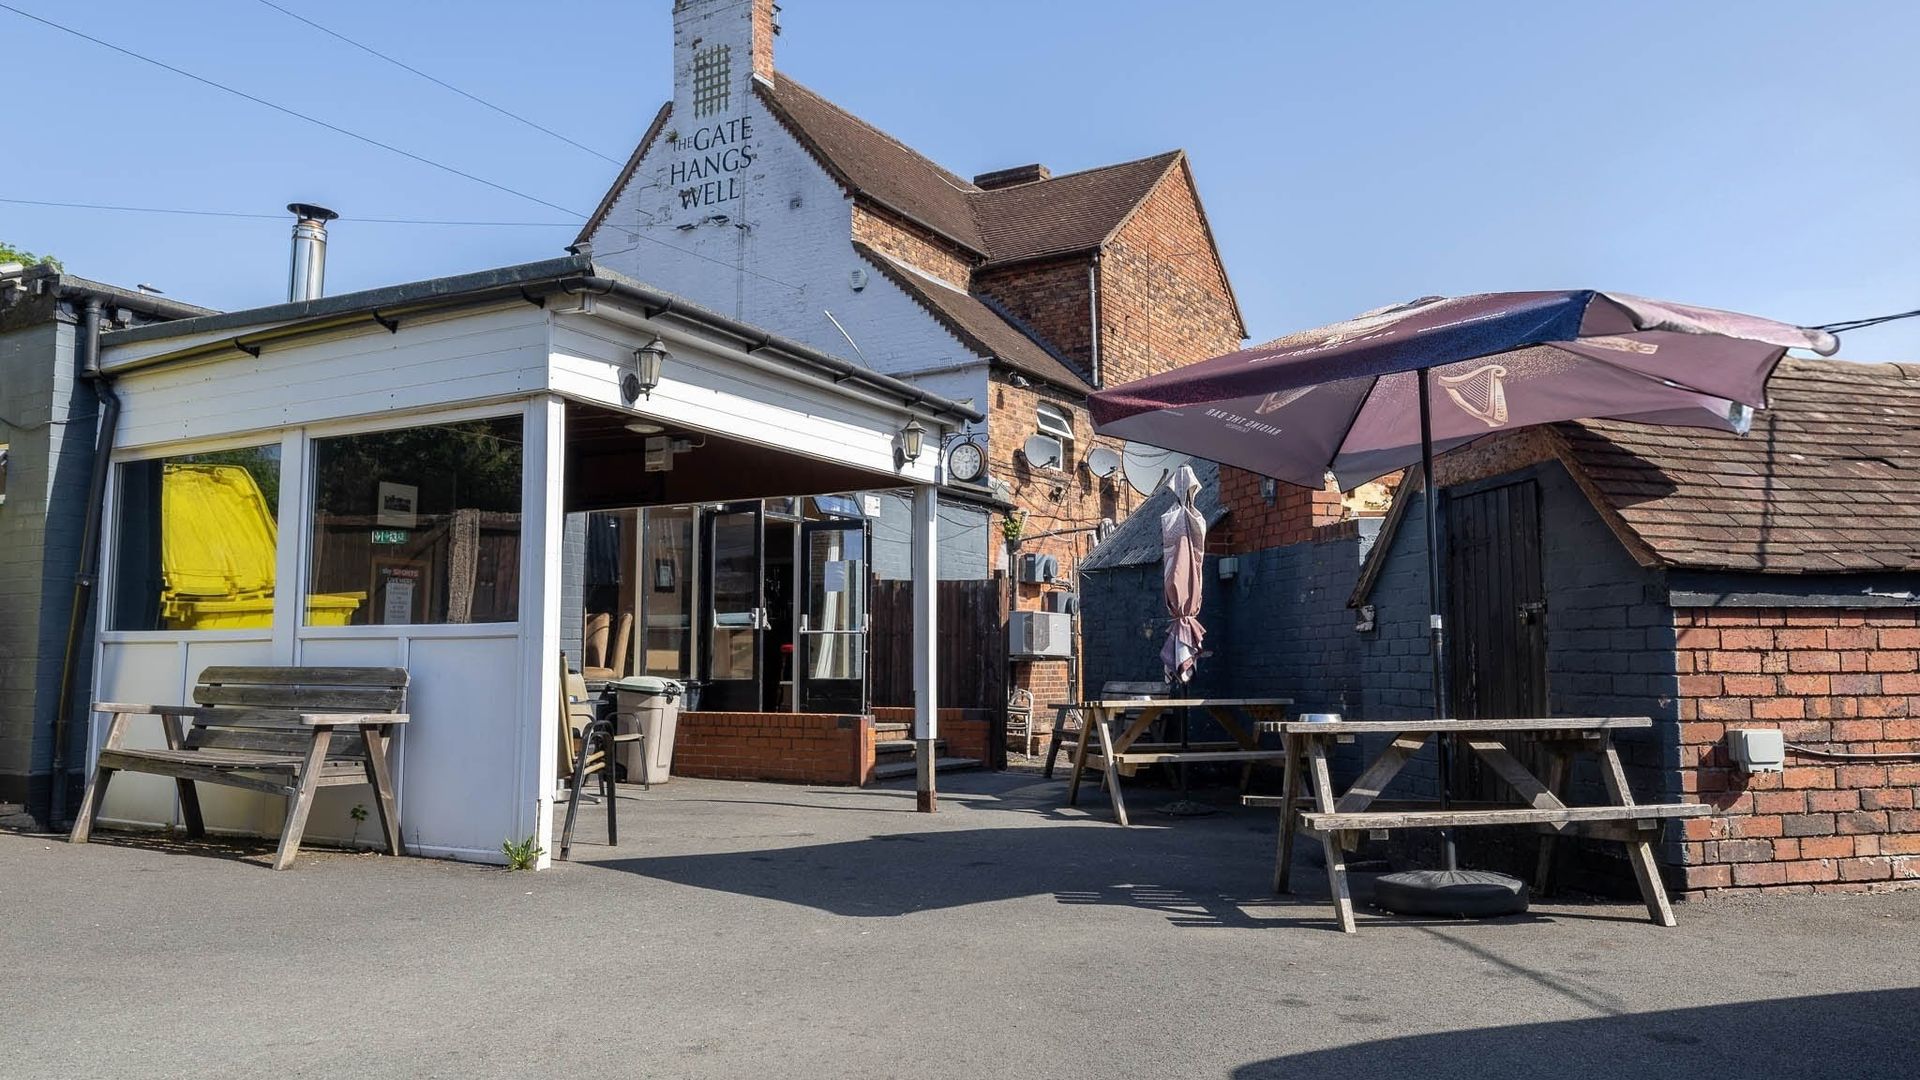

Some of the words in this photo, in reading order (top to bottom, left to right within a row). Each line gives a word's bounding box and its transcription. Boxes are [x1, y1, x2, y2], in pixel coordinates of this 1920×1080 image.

[673, 136, 694, 152] THE
[693, 116, 753, 151] GATE
[670, 145, 752, 185] HANGS
[679, 178, 740, 210] WELL
